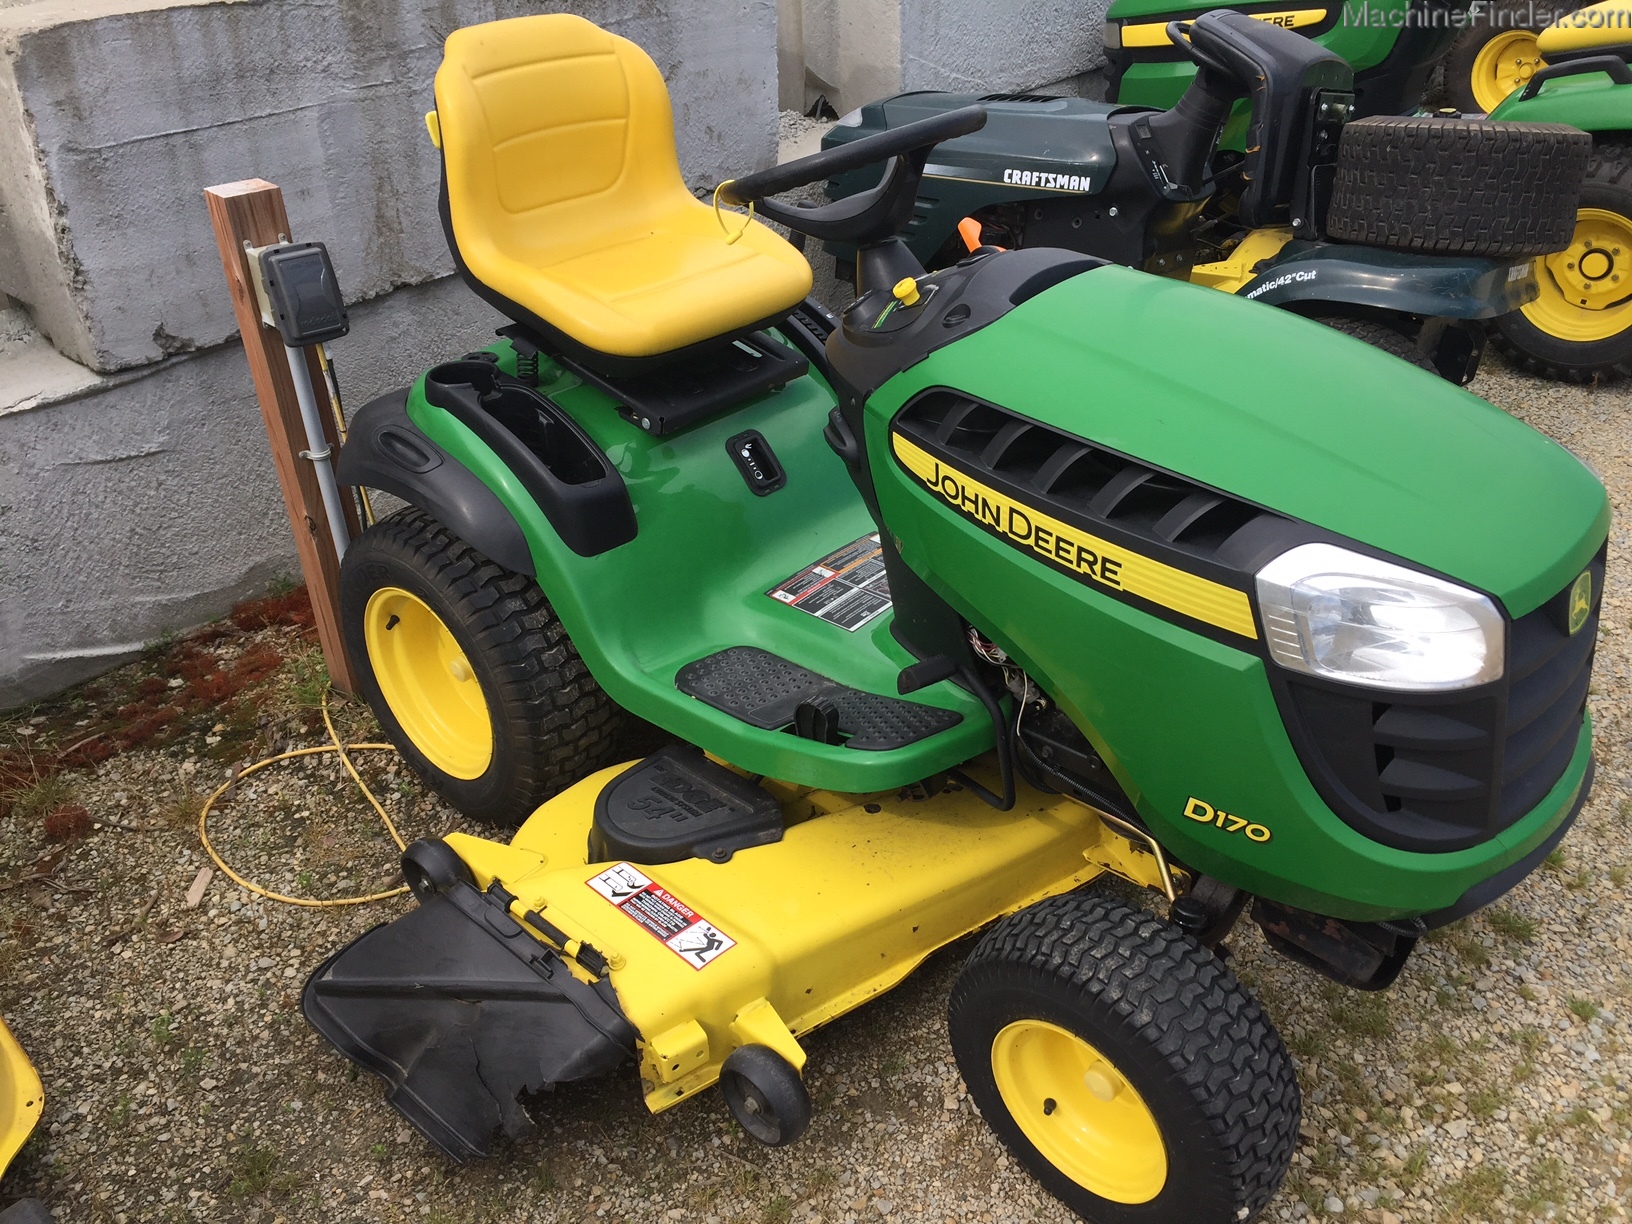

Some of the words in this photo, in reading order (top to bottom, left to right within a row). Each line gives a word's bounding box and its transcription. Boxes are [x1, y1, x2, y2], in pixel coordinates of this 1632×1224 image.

[1003, 168, 1091, 192] CRAFTSMAN
[926, 462, 1002, 529] JOHN
[1008, 506, 1123, 586] DEERE
[626, 794, 689, 823] 54"
[1183, 796, 1271, 842] D170
[661, 893, 694, 918] DANGER
